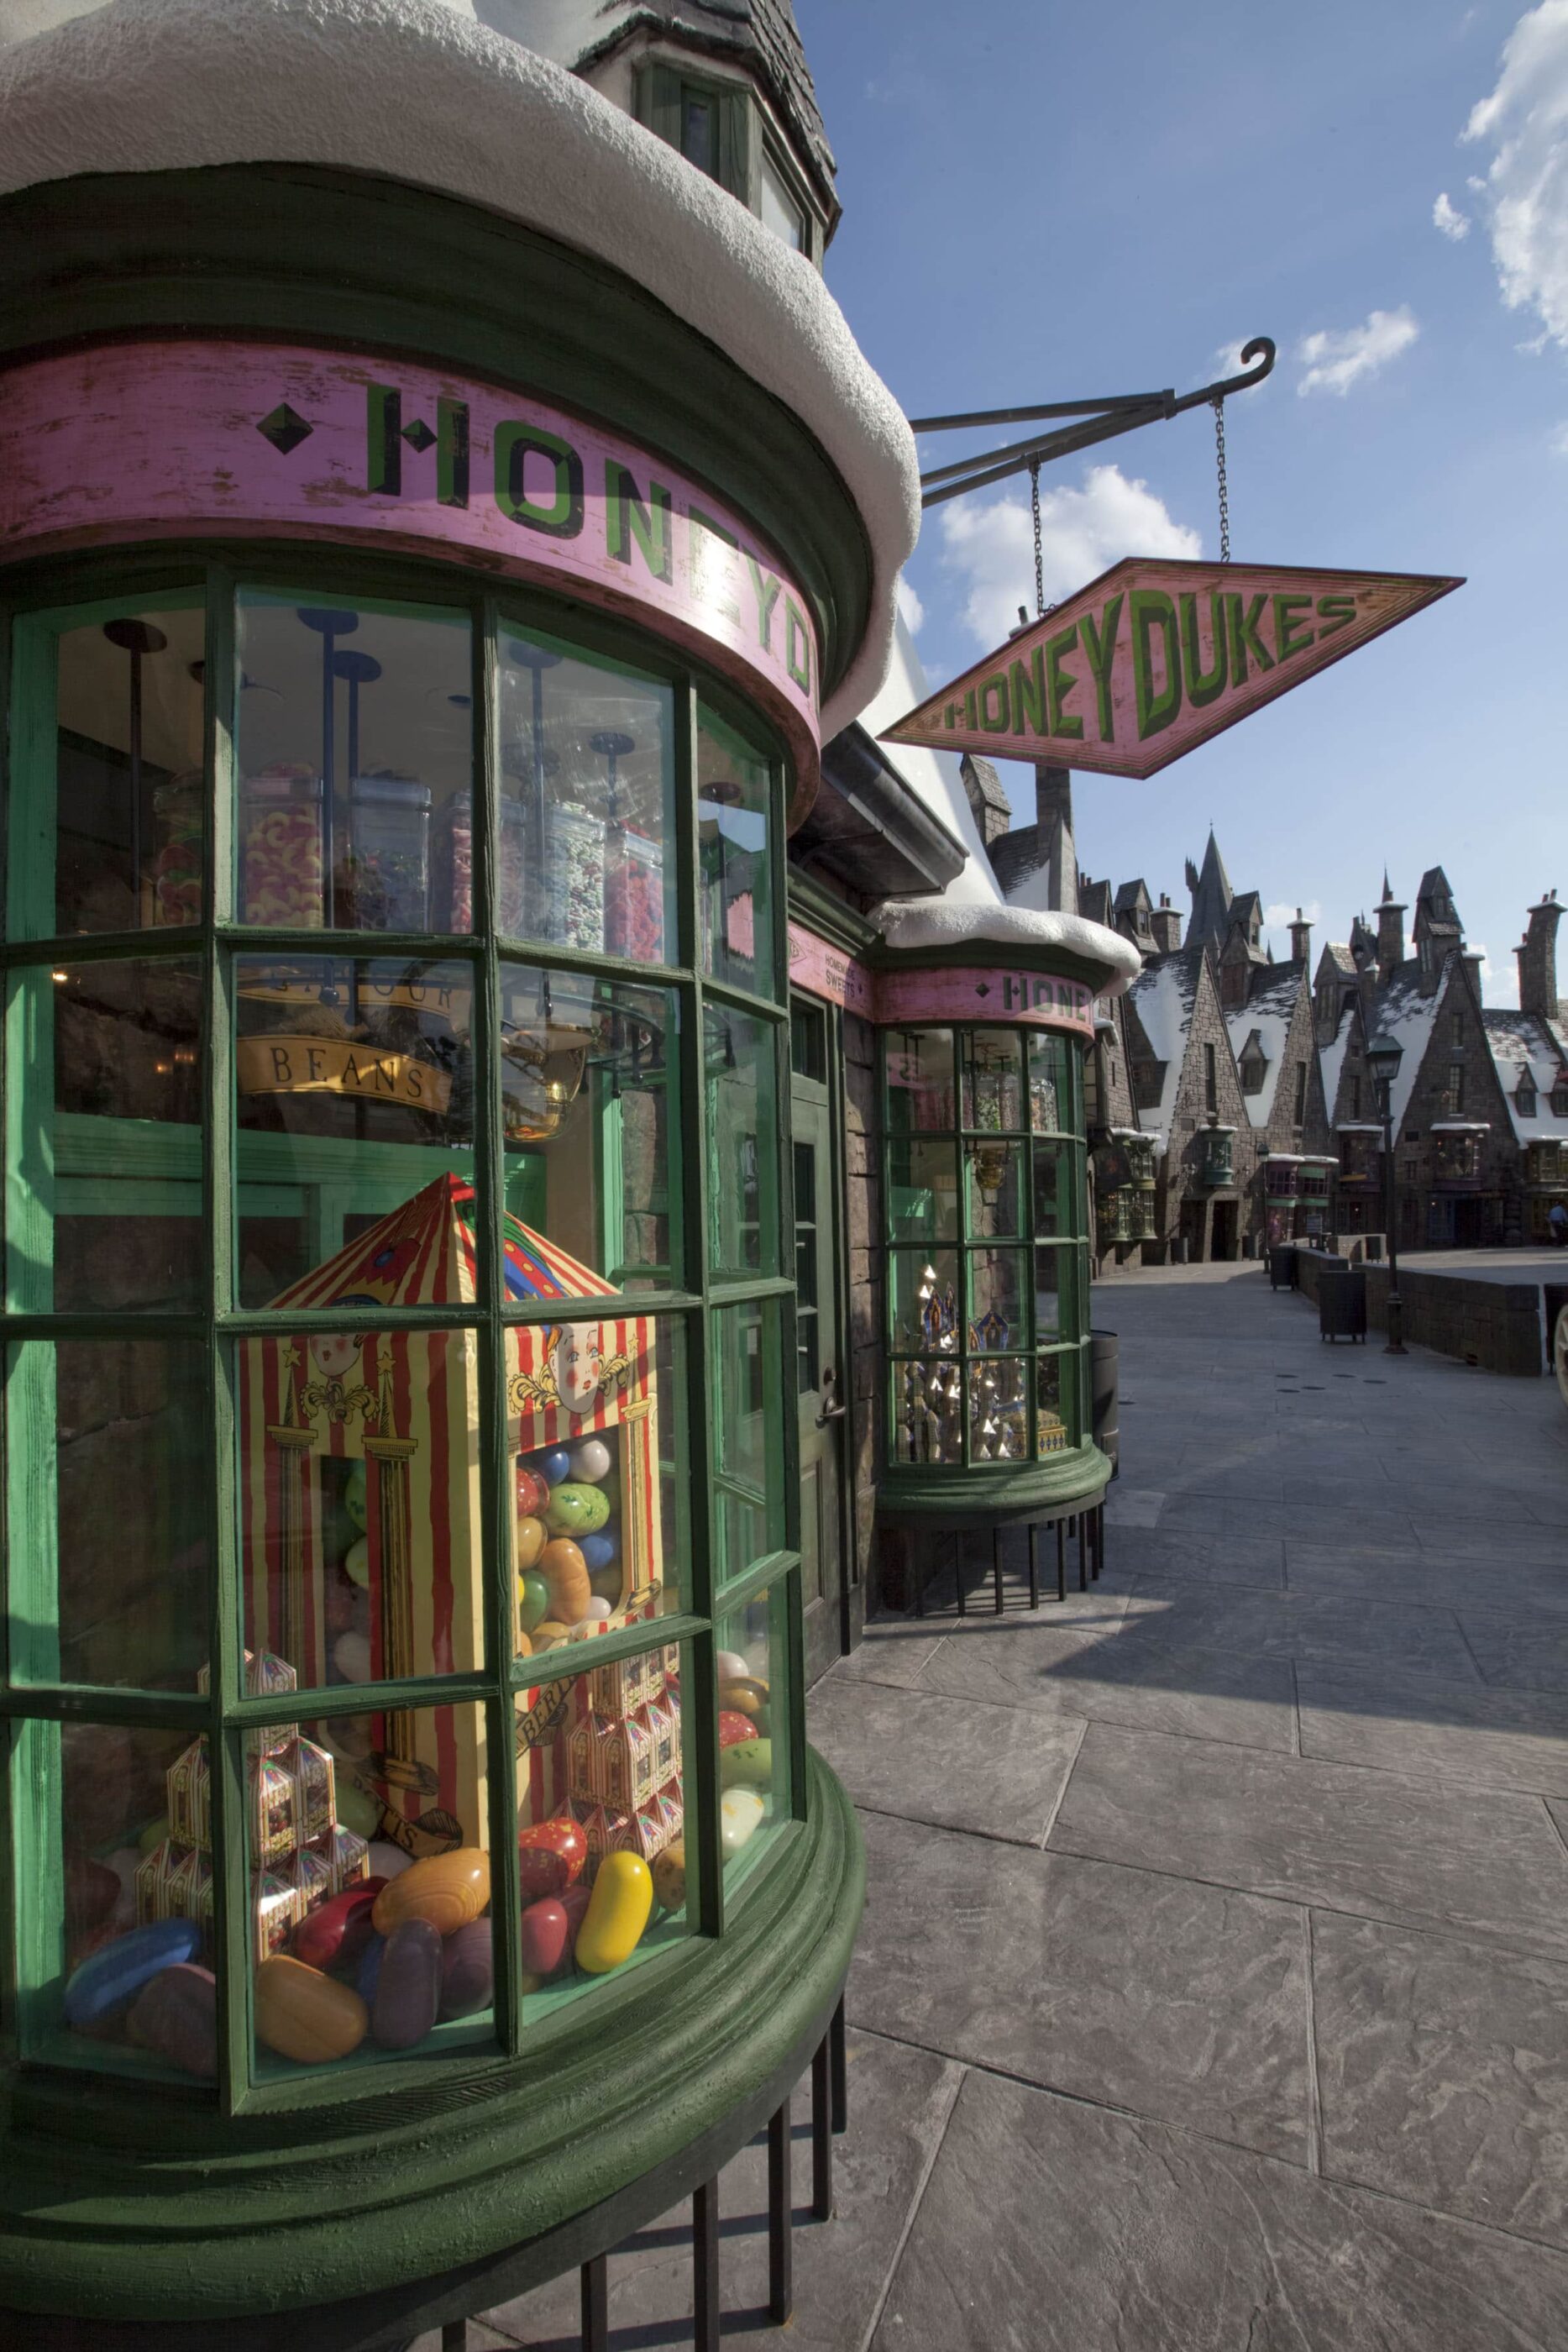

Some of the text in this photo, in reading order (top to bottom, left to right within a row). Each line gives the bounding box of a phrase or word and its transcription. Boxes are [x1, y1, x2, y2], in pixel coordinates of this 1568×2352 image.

[367, 384, 819, 721] HONEYD
[944, 590, 1358, 743] HONEYDUKES
[826, 969, 855, 998] SWEETS
[1003, 976, 1091, 1025] HONE
[270, 1047, 423, 1099] BEANS
